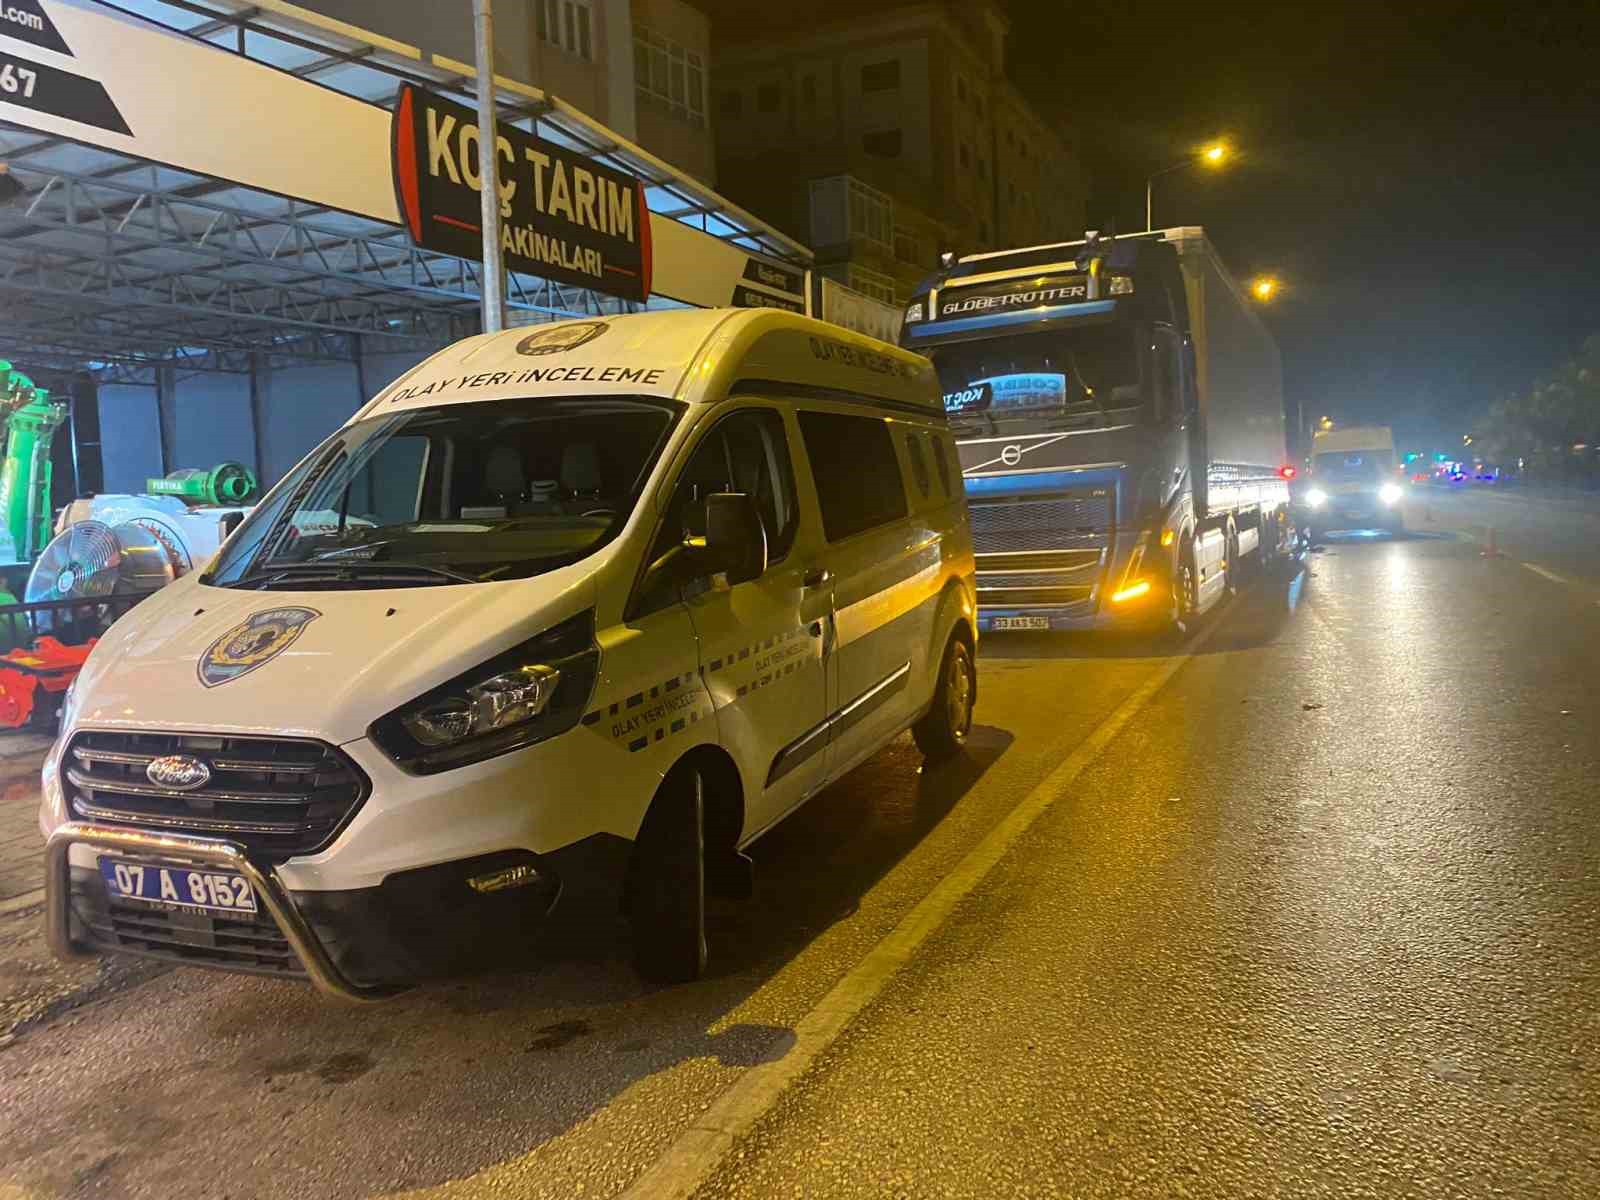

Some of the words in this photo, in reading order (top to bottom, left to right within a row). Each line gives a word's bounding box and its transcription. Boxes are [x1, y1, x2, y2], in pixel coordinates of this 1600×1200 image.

[0, 64, 36, 98] 67
[427, 107, 517, 218] KOÇ
[525, 147, 634, 242] TARIM
[502, 223, 603, 278] AKİNALARI
[943, 286, 1086, 315] GLOBETROTTER
[391, 378, 457, 403] OLAY
[612, 714, 641, 738] OLAY
[115, 864, 144, 895] 07
[160, 869, 179, 901] A
[187, 872, 253, 908] 8152
